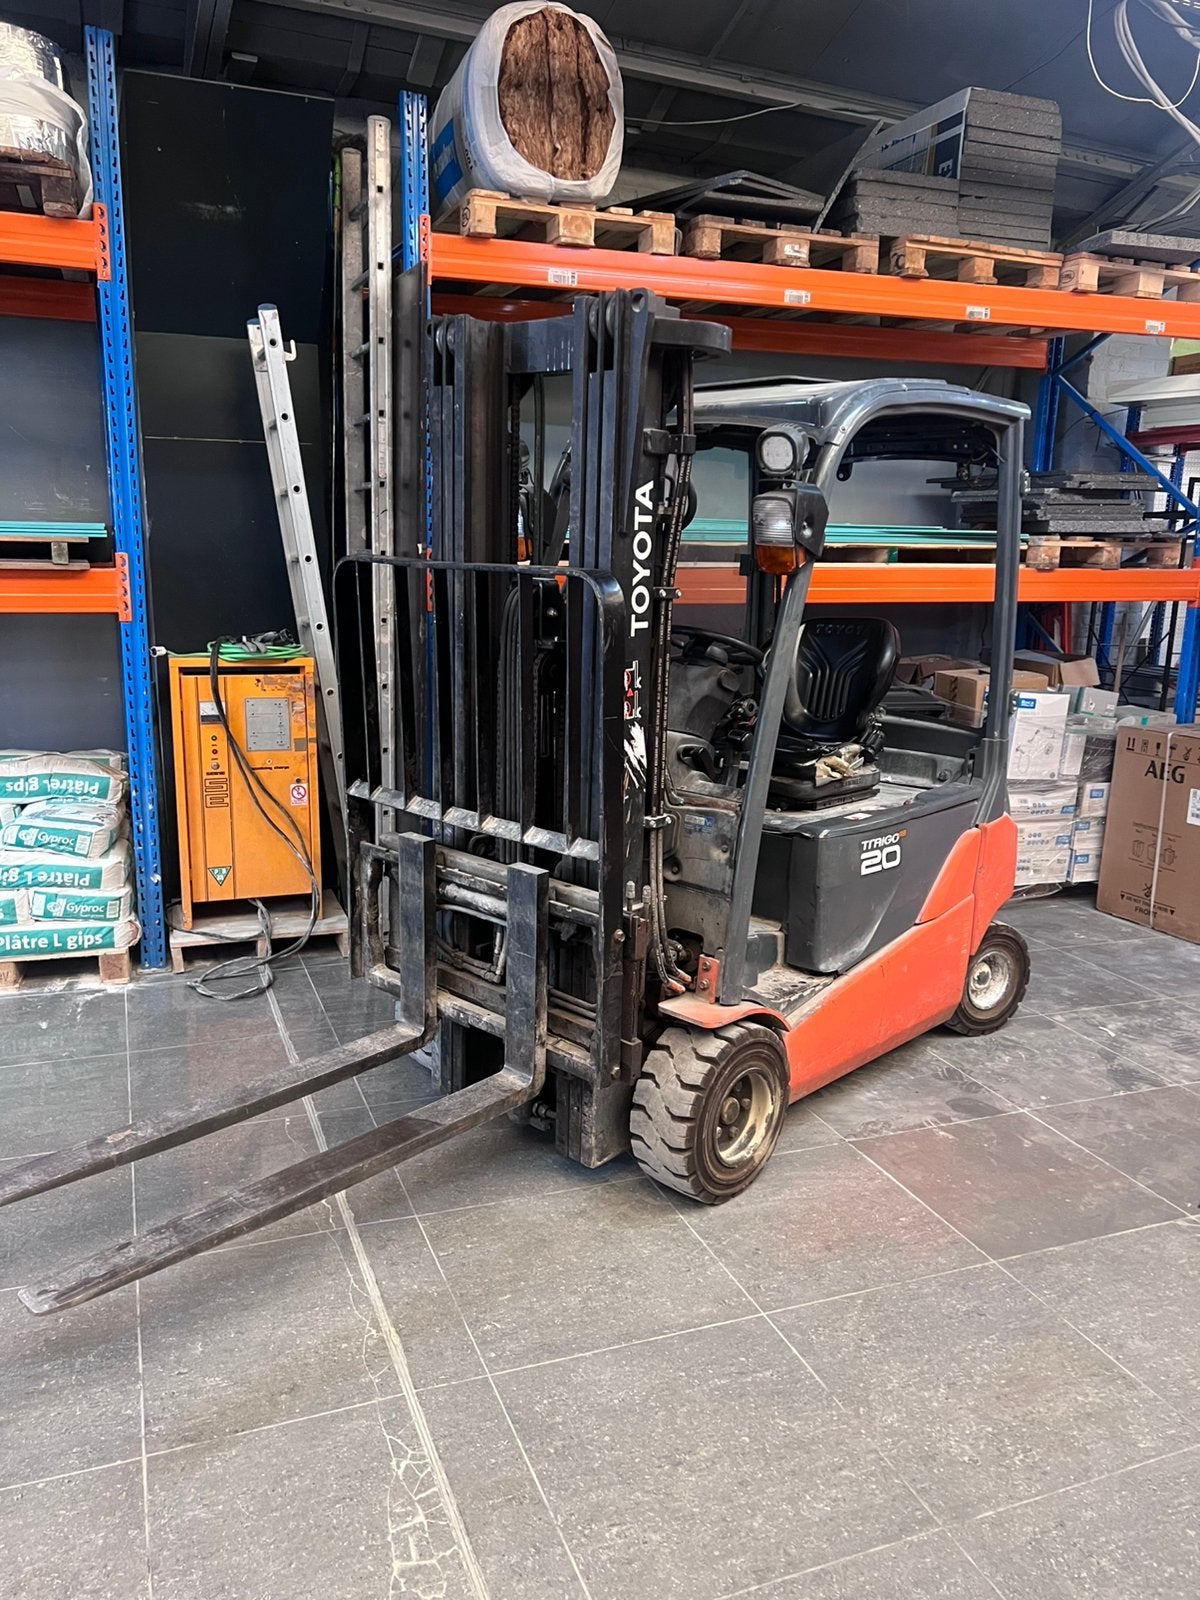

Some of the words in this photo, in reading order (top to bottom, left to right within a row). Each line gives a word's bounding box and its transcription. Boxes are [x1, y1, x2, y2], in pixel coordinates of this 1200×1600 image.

[630, 480, 655, 637] TOYOTA
[1144, 760, 1186, 784] AEG
[5, 777, 39, 797] gips
[50, 779, 100, 795] Plâtre
[37, 831, 76, 846] Gyproc
[860, 844, 901, 876] 20
[24, 871, 32, 884] L
[38, 871, 90, 886] Plâtre
[66, 902, 105, 914] Gyproc
[1134, 906, 1158, 918] FROT
[53, 933, 62, 947] L
[67, 931, 103, 950] gips
